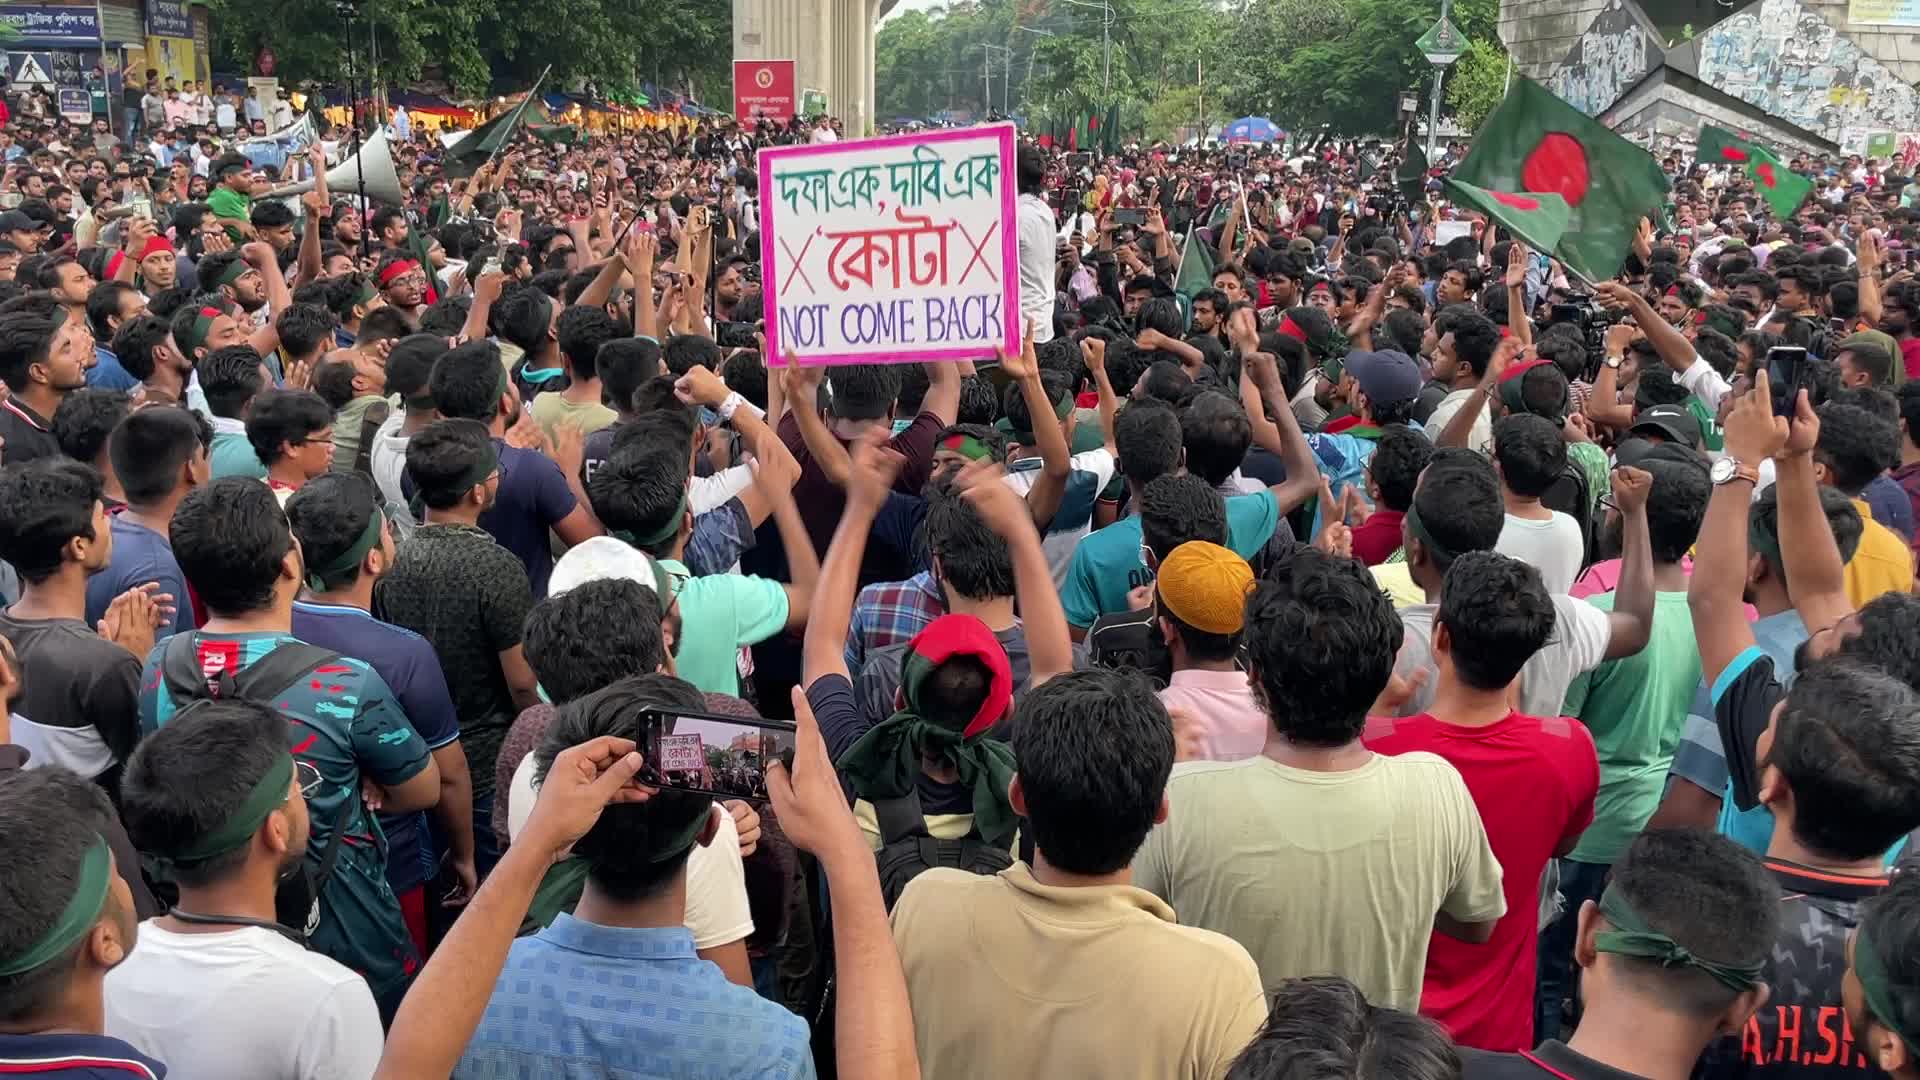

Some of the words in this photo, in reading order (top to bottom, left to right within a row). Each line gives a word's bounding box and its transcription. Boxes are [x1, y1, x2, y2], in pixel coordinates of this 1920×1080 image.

[26, 12, 53, 26] ট্রাফিক
[55, 12, 78, 30] পুলিশ
[774, 169, 836, 215] দফা
[884, 144, 946, 208] দাবি
[944, 154, 1000, 200] এক
[780, 304, 829, 349] NOT
[841, 299, 916, 345] COME
[923, 293, 1003, 342] BACK
